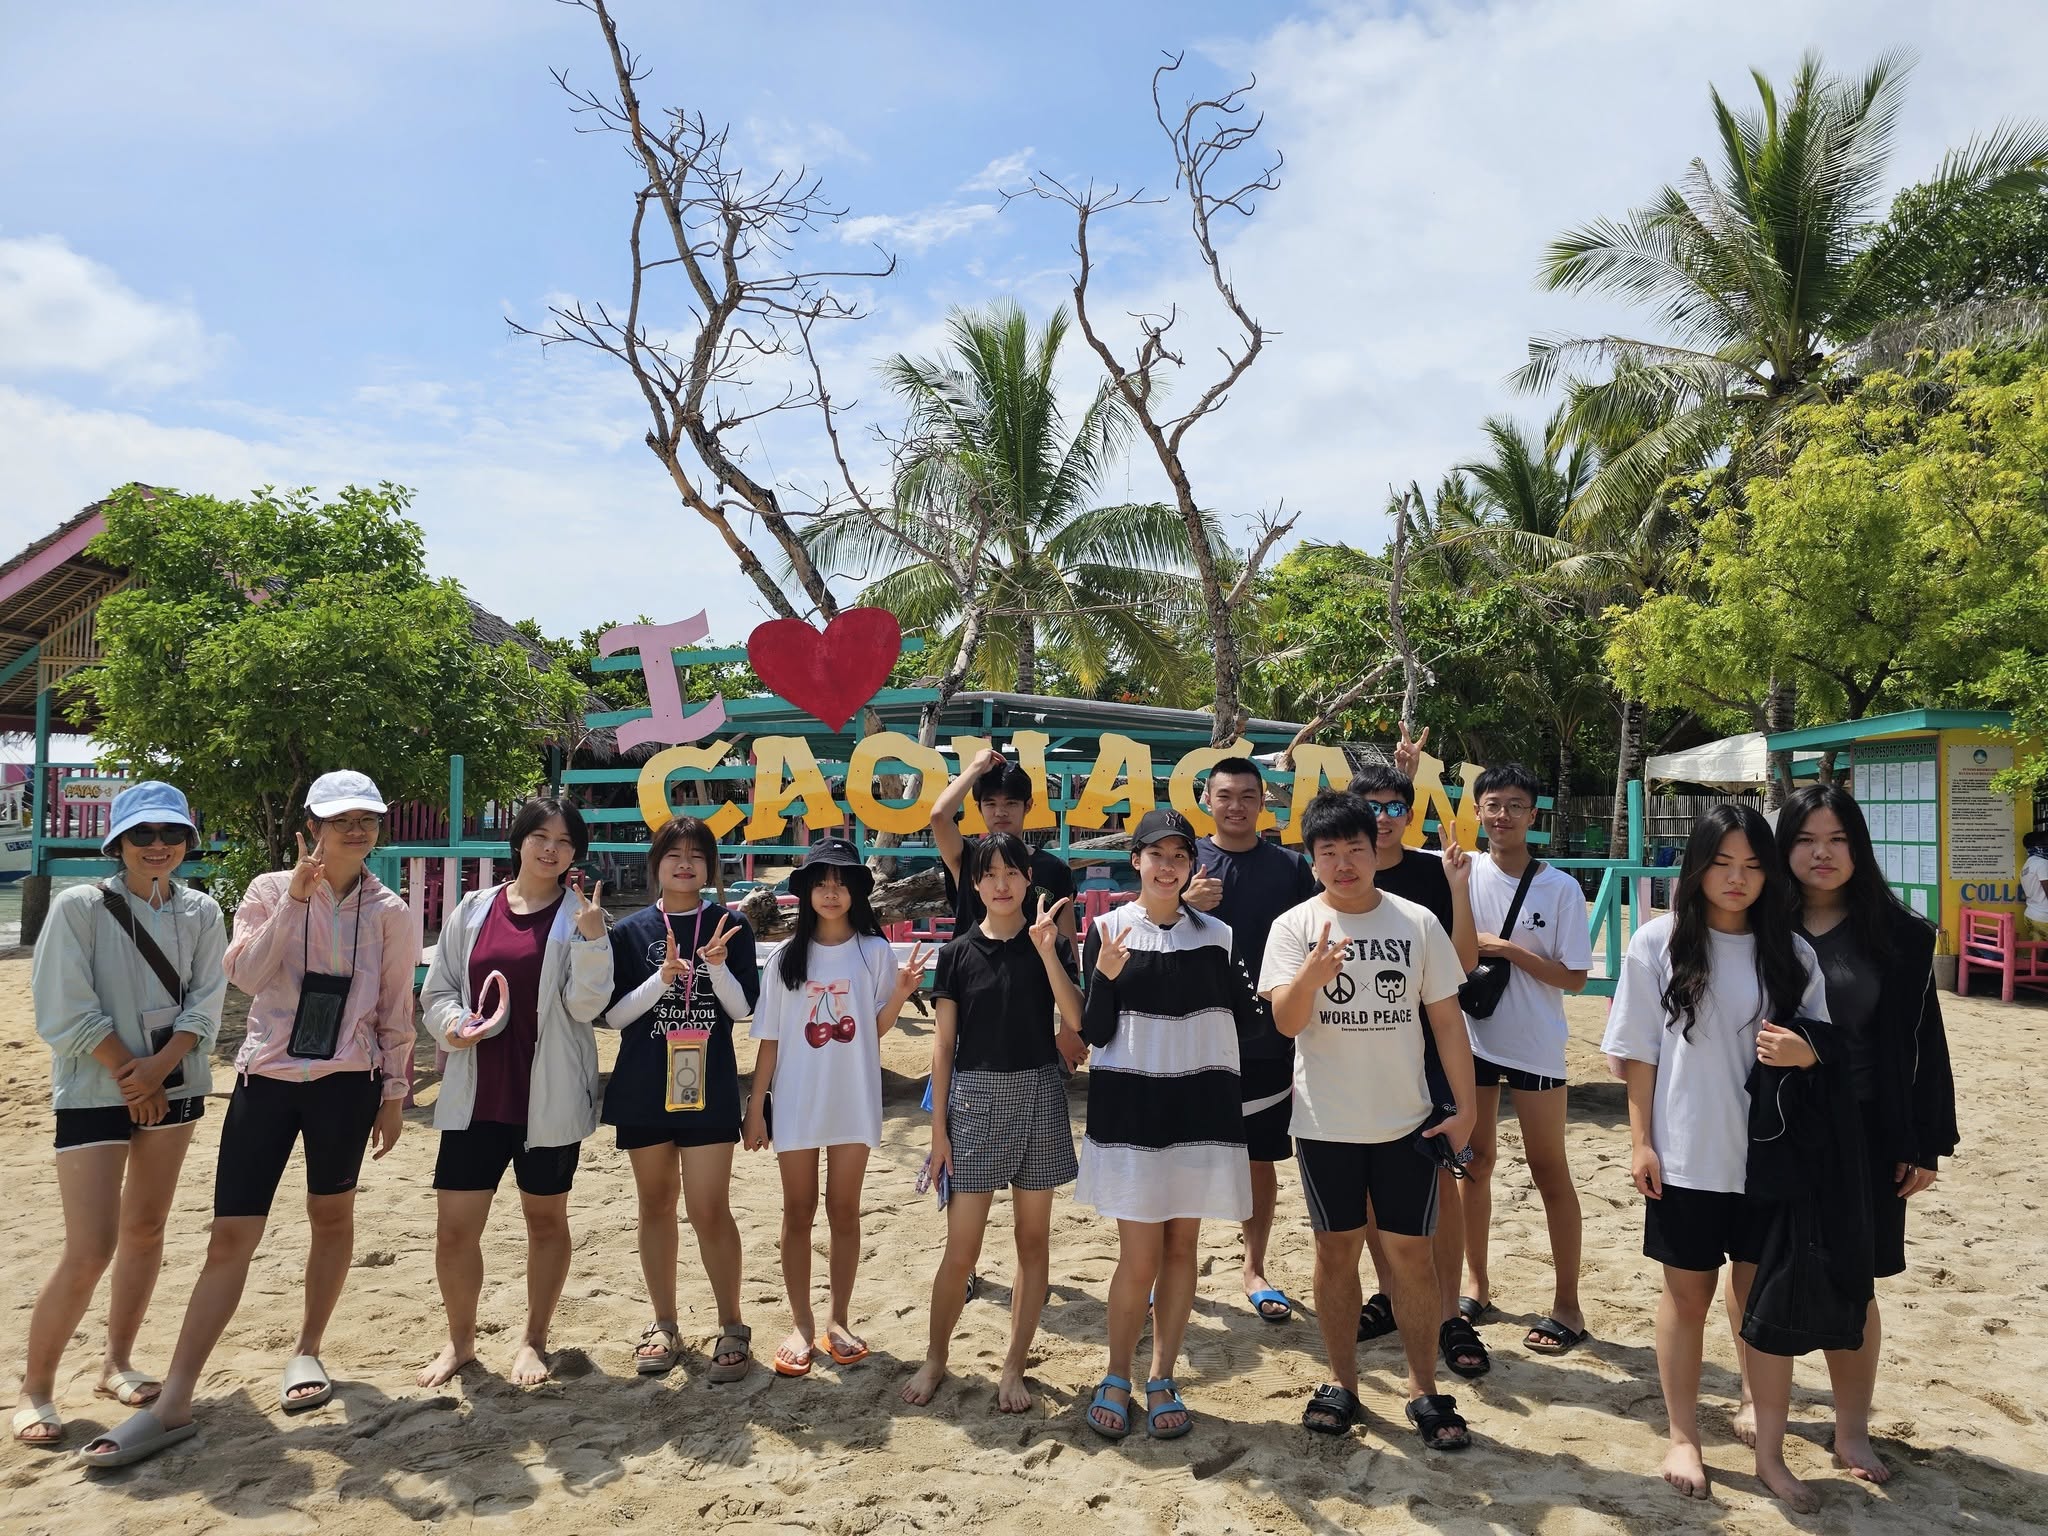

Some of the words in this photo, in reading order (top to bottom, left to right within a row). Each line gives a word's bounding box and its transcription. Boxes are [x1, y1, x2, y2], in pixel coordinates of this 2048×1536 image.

[599, 608, 726, 754] I
[690, 1009, 716, 1022] you
[1319, 1011, 1368, 1025] WORLD
[1373, 1009, 1412, 1024] PEACE
